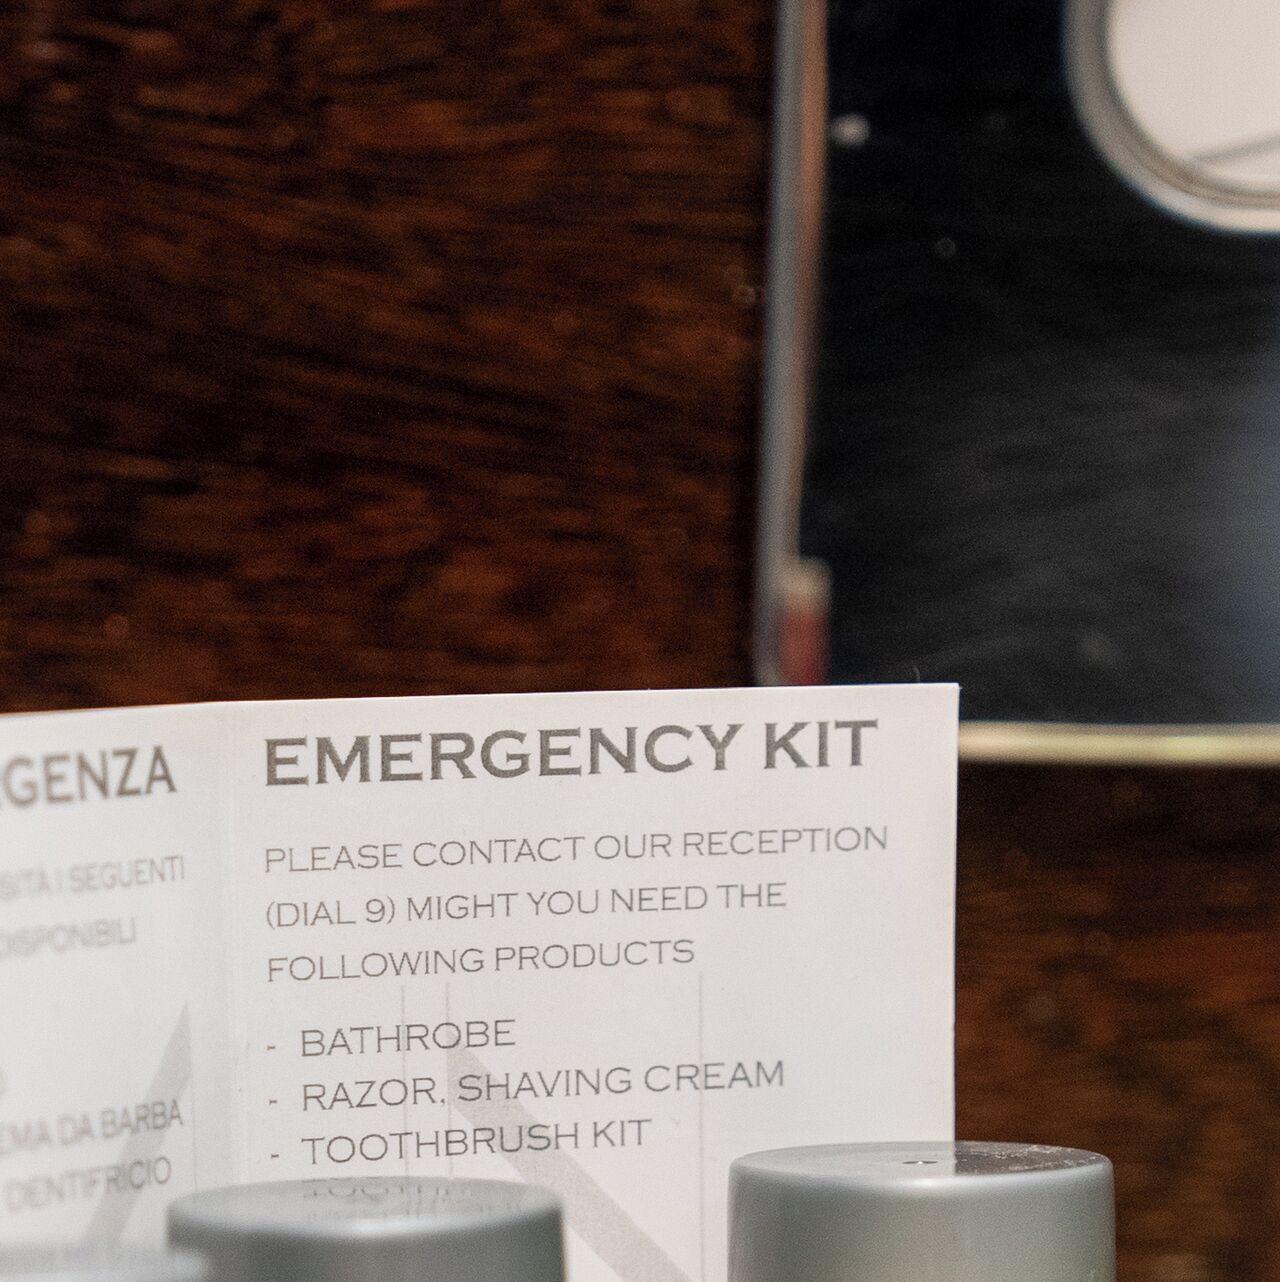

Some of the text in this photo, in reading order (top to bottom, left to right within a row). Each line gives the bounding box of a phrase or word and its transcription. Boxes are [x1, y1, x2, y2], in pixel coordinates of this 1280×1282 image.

[264, 718, 879, 787] EMERGENCY KIT
[264, 825, 889, 874] PLEASE CONTACT OUR RECEPTION
[68, 855, 185, 893] SEGUENTI
[265, 882, 787, 930] (DIAL 9) MIGHT YOU NEED THE
[266, 938, 695, 984] FOLLOWING PRODUCTS
[301, 1019, 516, 1057] BATHROBE
[457, 1068, 633, 1103] SHAVING
[642, 1060, 786, 1094] CREAM
[56, 1111, 97, 1145] DA
[101, 1098, 184, 1139] BARBA
[301, 1118, 653, 1164] TOOTHBRUSH KIT
[5, 1155, 172, 1211] DENTIFRICIO
